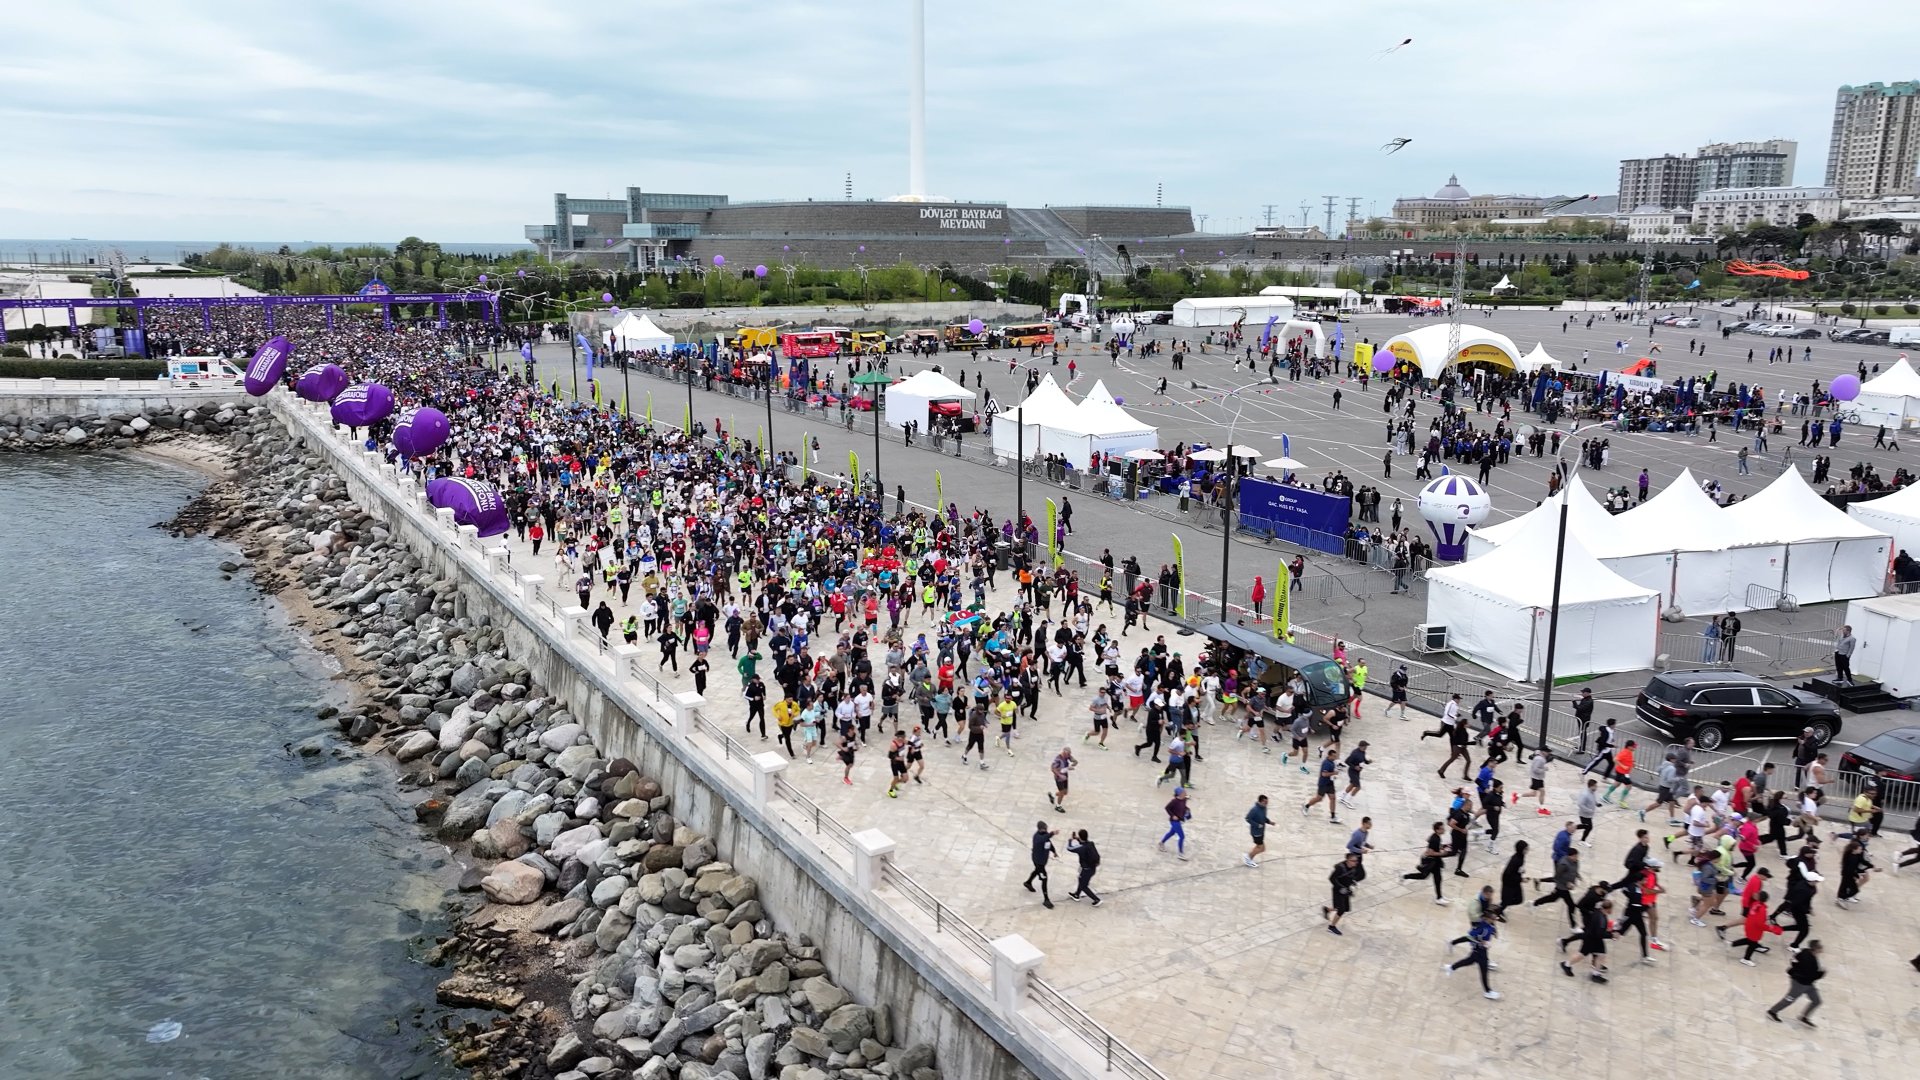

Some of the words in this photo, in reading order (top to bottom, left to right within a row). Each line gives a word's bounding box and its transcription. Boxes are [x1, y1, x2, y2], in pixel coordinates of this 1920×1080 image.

[920, 207, 958, 219] DÖVLƏT
[961, 207, 1002, 219] BAYRAĞI
[940, 219, 986, 229] MEYDANI
[486, 492, 497, 510] BAKI
